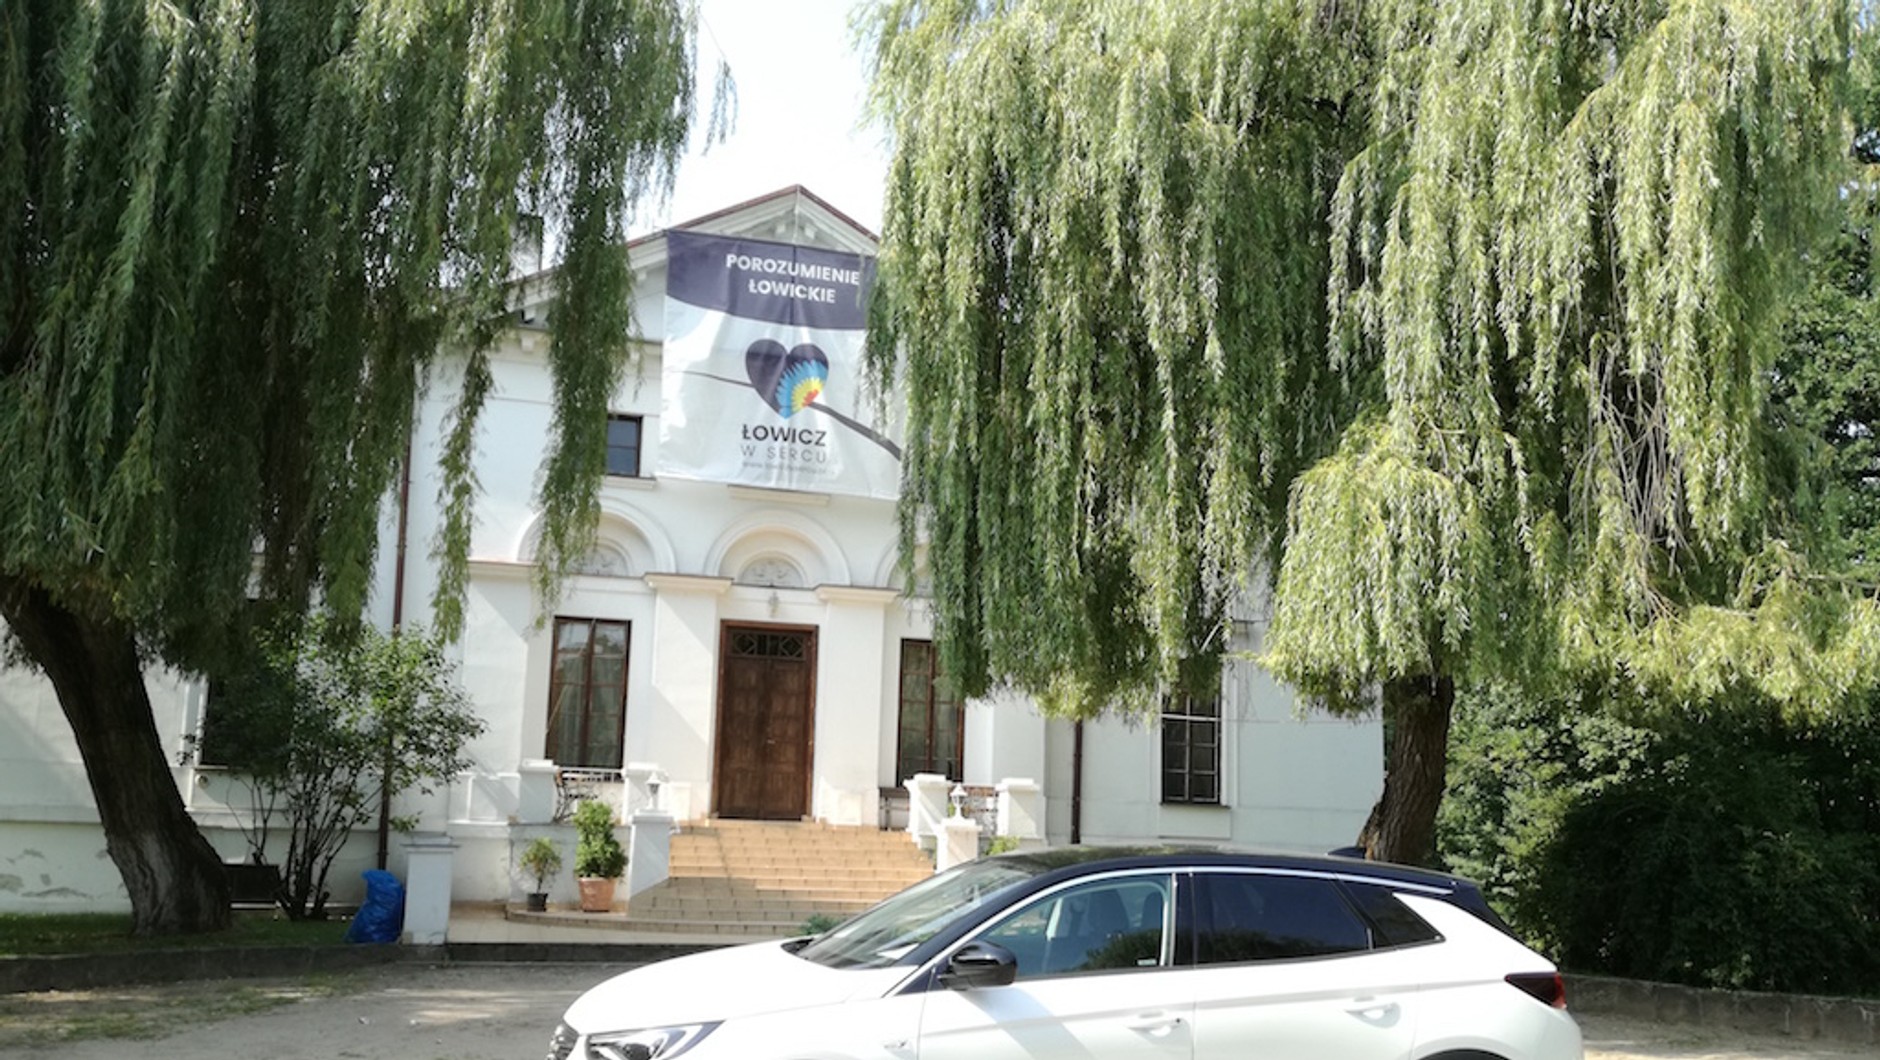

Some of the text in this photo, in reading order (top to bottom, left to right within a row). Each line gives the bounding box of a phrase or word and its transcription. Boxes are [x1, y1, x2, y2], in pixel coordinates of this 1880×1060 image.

[725, 253, 860, 286] POROZUMIENIE
[748, 279, 836, 303] ŁOWICKIE
[742, 424, 827, 447] ŁOWICZ
[740, 444, 826, 463] W SERCU
